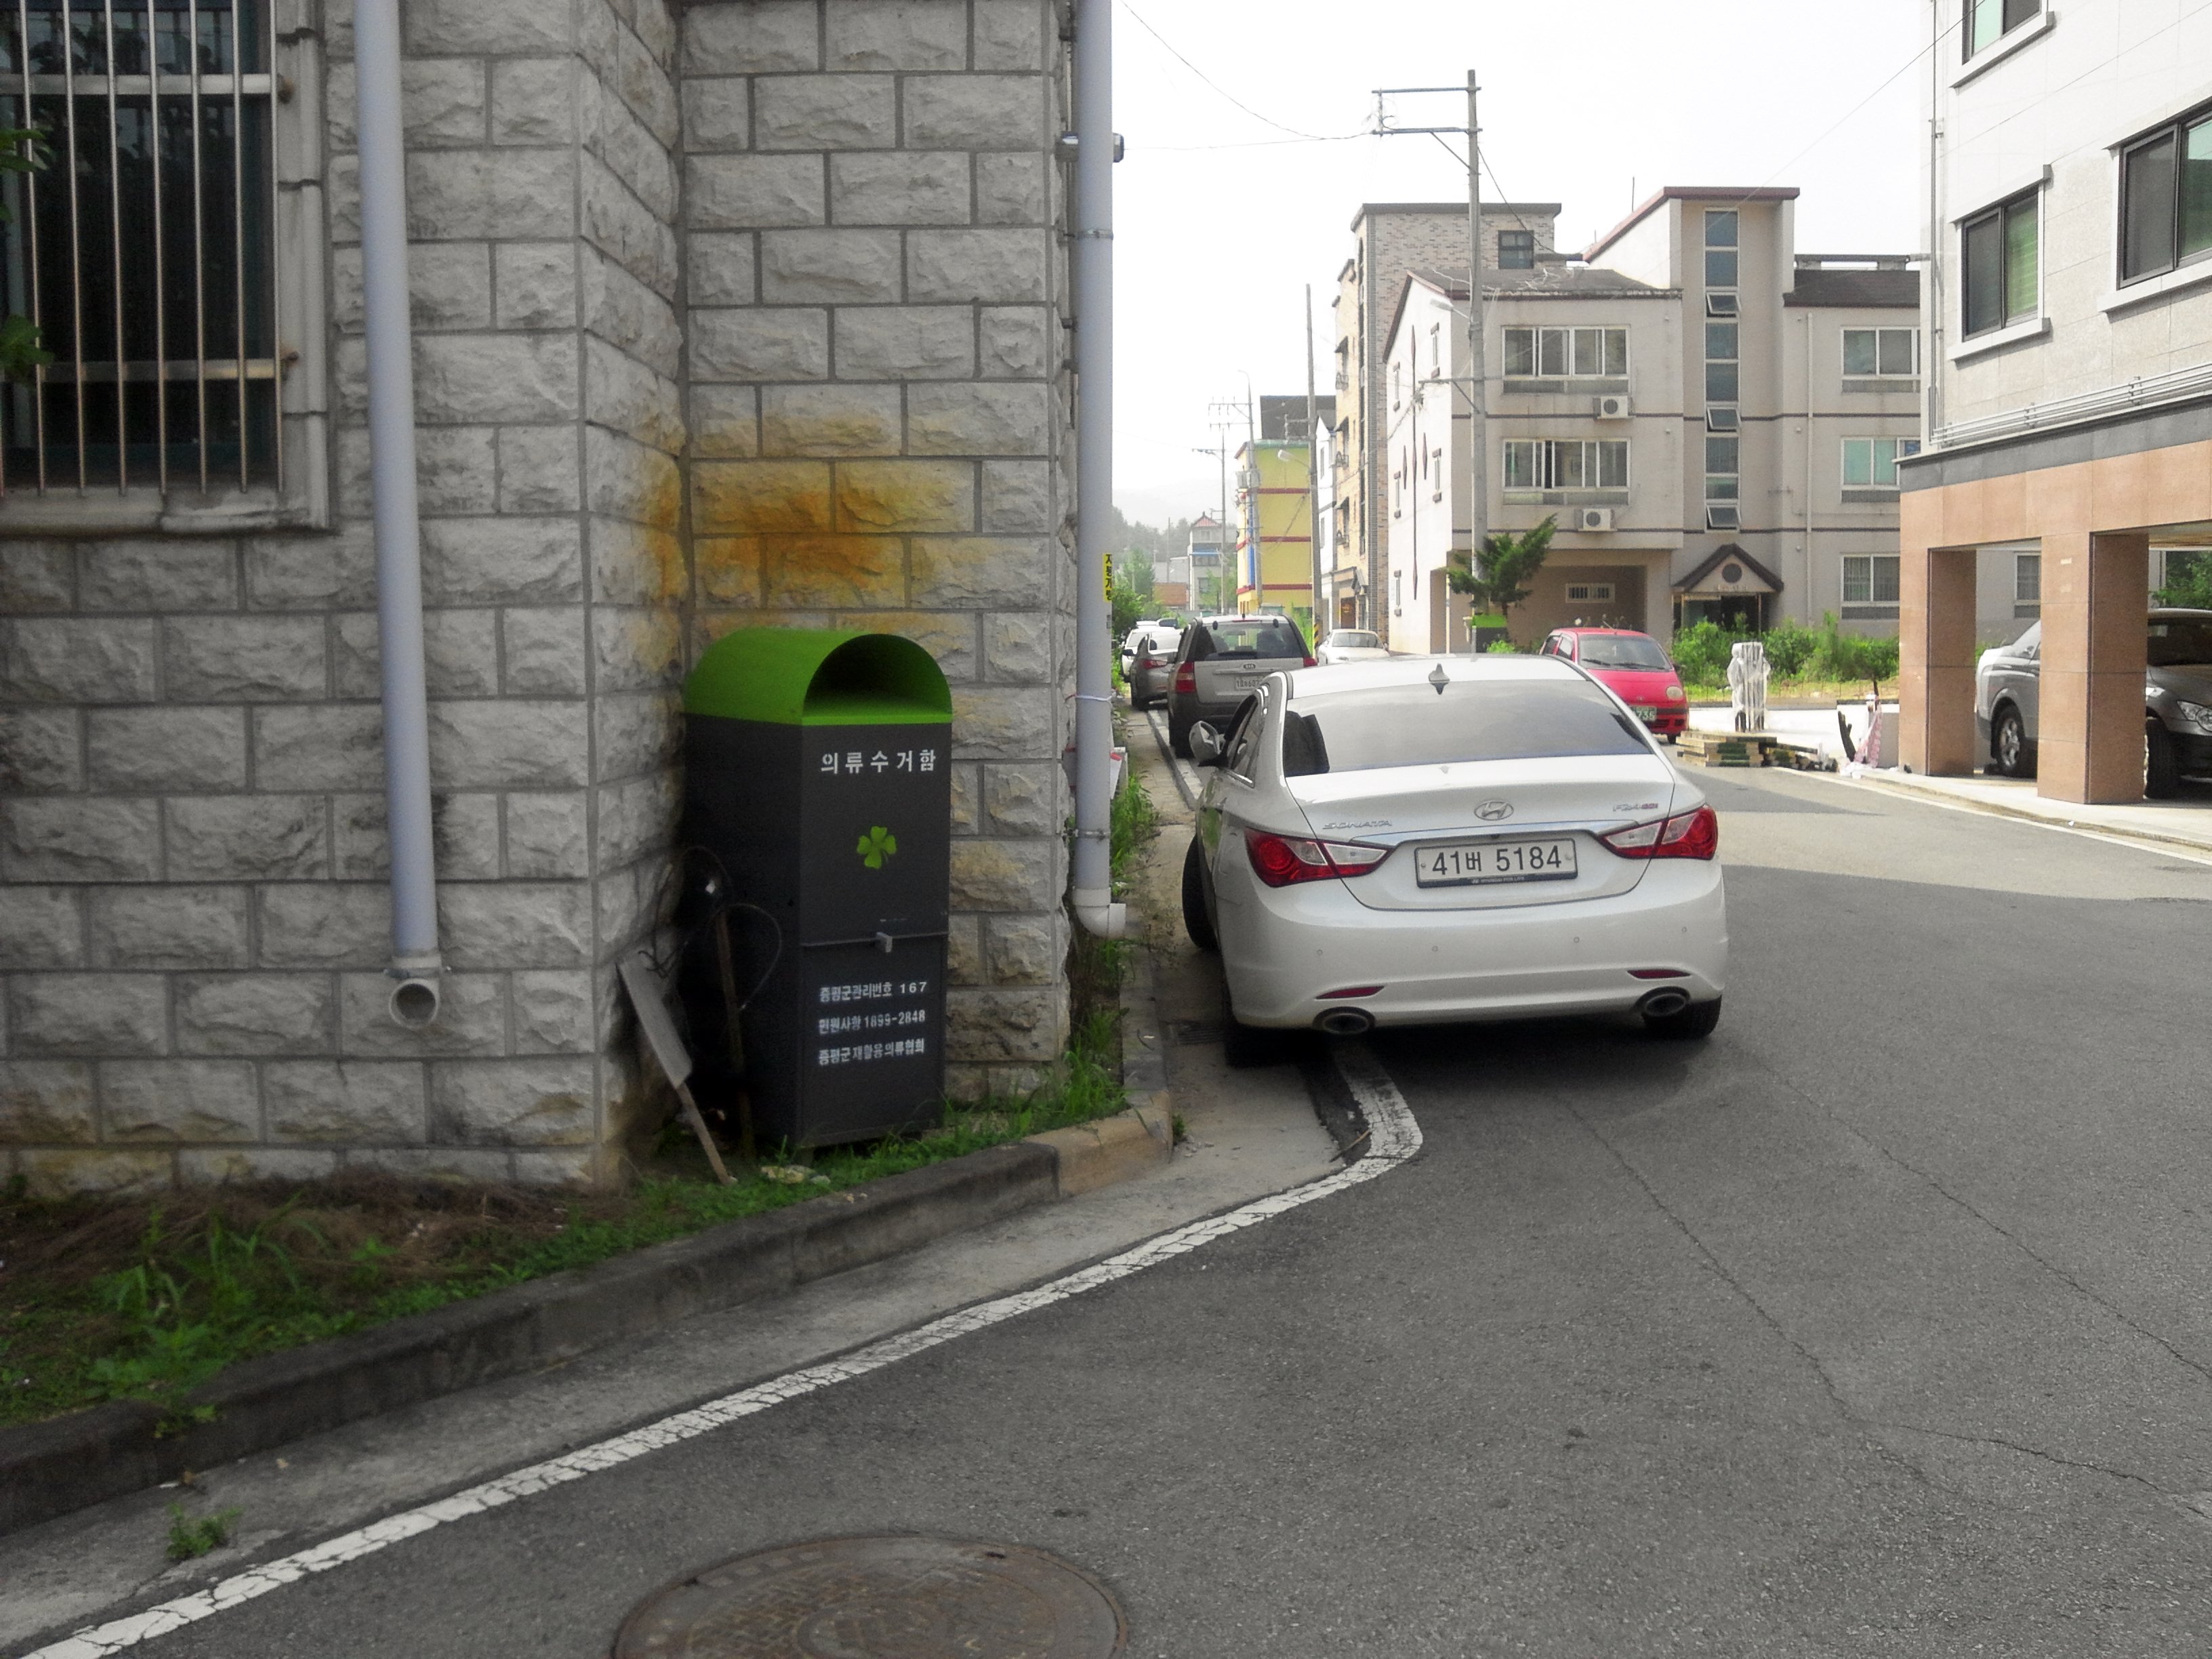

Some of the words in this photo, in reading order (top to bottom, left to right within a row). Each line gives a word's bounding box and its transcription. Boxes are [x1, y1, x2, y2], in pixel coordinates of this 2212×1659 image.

[821, 750, 937, 775] 의류수거함
[1432, 851, 1482, 876] 41버
[1496, 845, 1562, 872] 5184
[899, 981, 927, 994] 167
